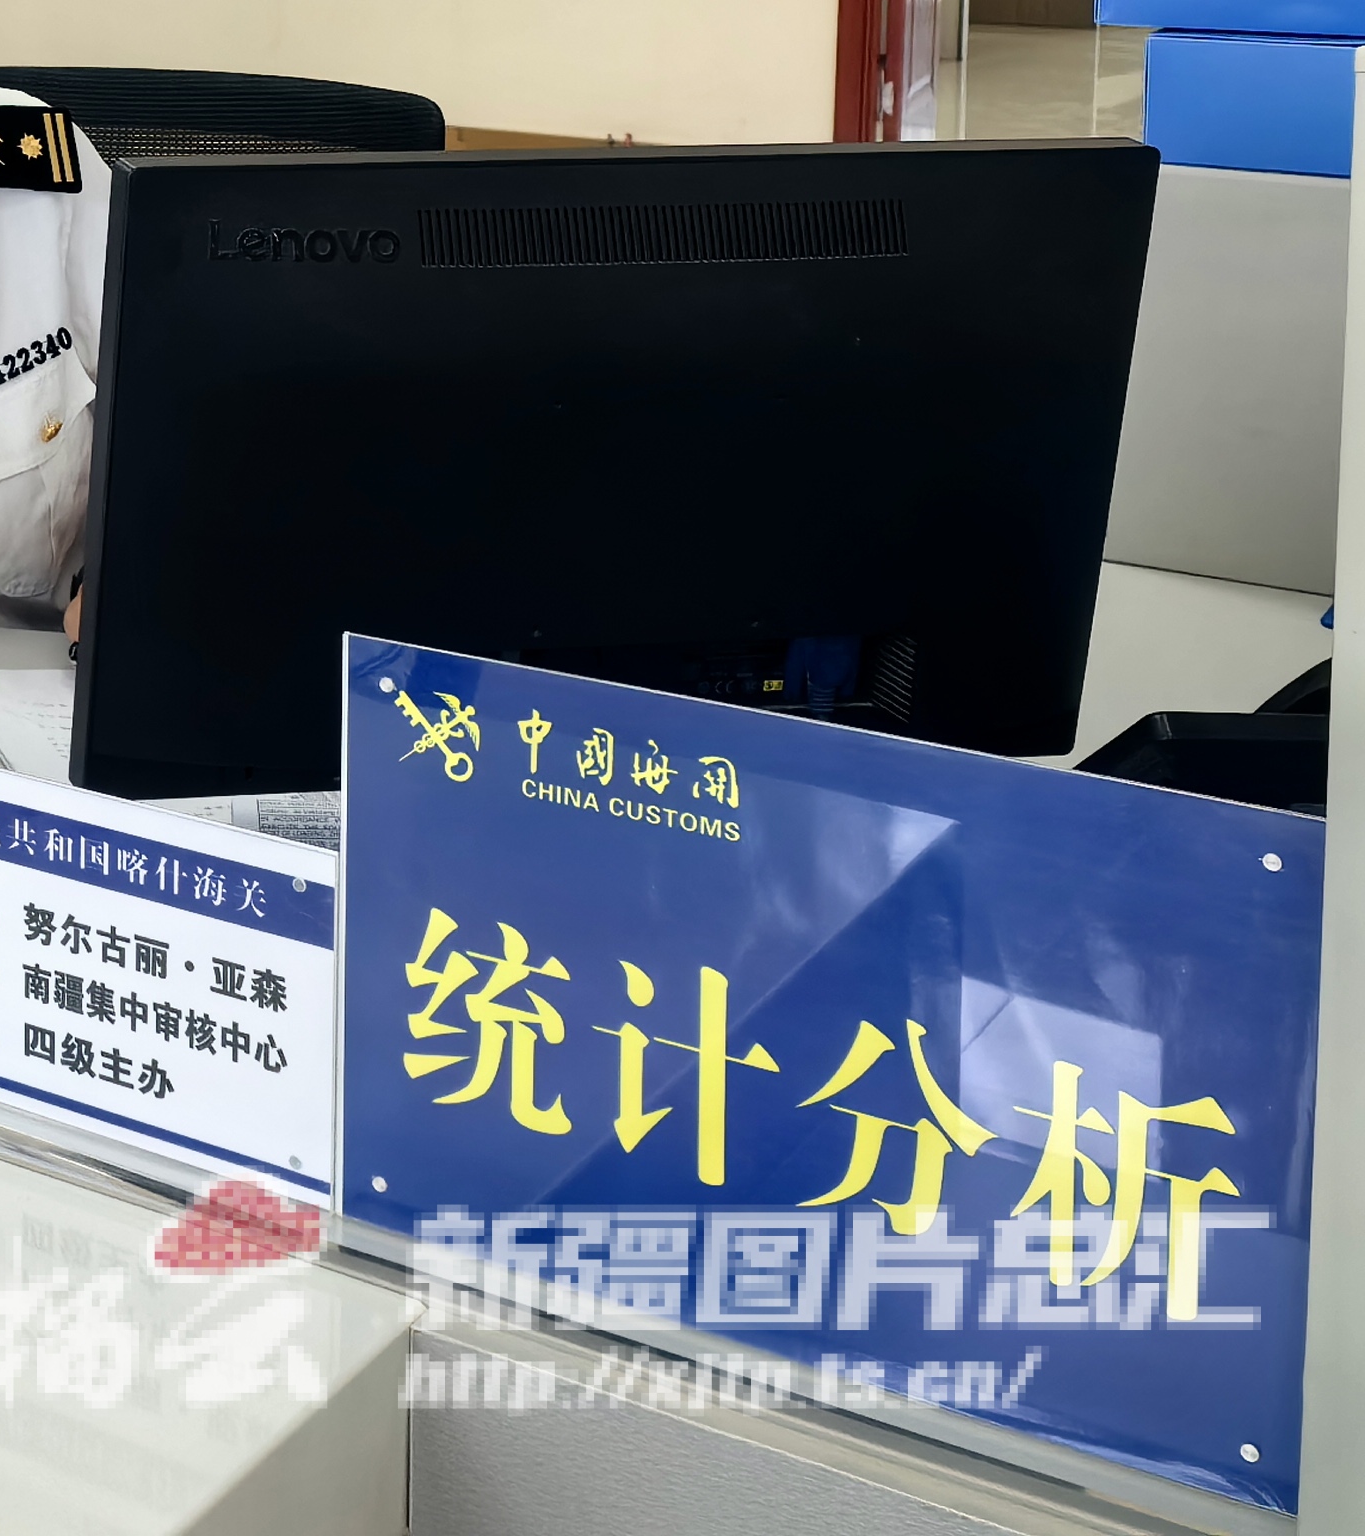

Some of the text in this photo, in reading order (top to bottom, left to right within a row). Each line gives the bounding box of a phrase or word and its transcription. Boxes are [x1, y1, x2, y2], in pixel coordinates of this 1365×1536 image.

[208, 218, 401, 263] Lenovo
[521, 778, 741, 842] CHINA CUSTOMS
[402, 907, 1241, 1322] 统计分析
